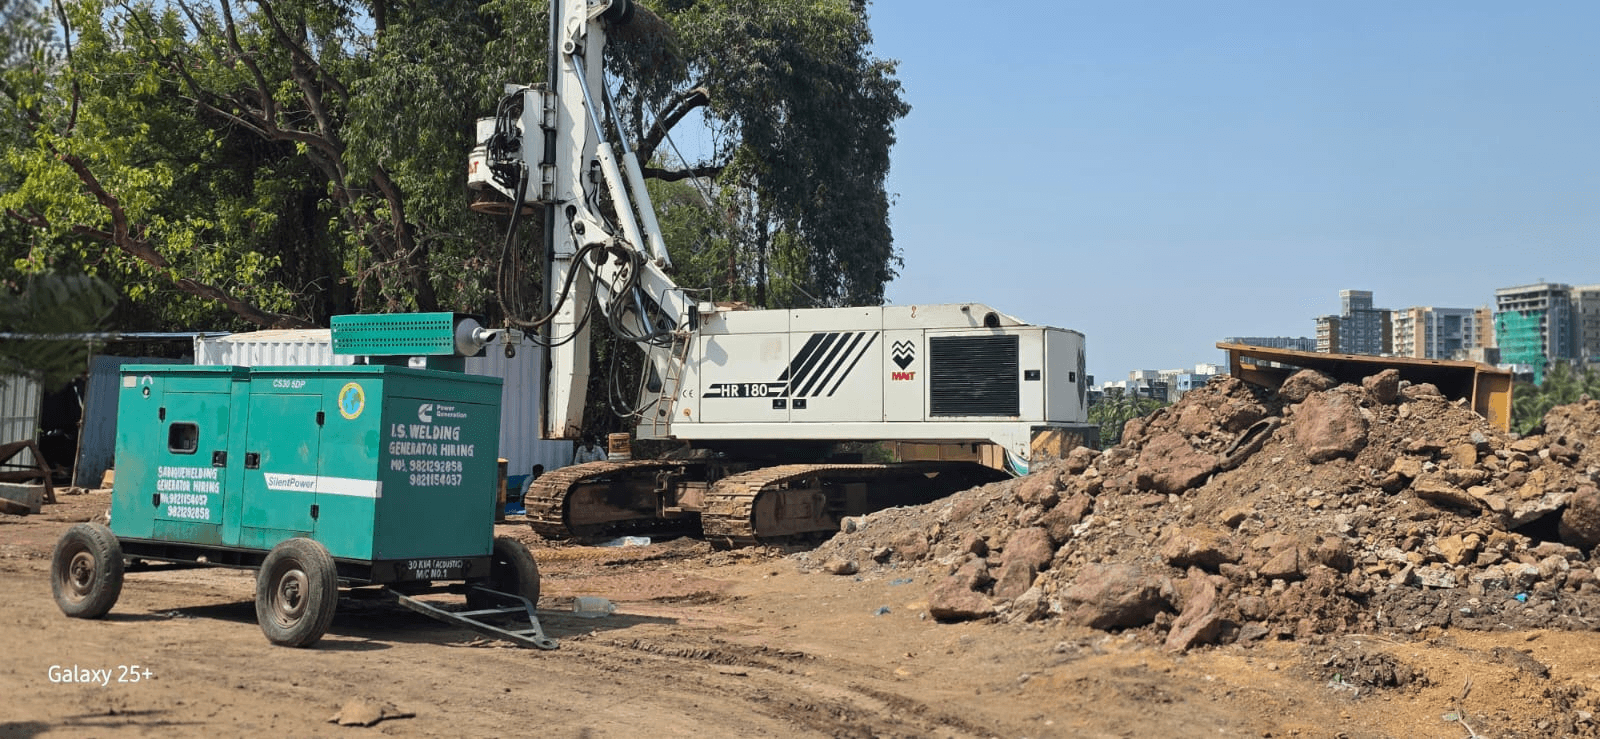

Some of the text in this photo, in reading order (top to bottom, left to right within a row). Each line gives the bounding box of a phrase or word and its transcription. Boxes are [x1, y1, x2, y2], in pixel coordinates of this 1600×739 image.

[721, 383, 768, 397] HR 180
[409, 424, 460, 441] WELDING
[389, 441, 474, 457] GENERATOR HIRING
[409, 460, 463, 473] 9821292858
[268, 476, 314, 489] SilentPower
[409, 473, 462, 486] 9821154037
[157, 479, 220, 494] GENERATOR HIRING
[408, 560, 418, 570] 30
